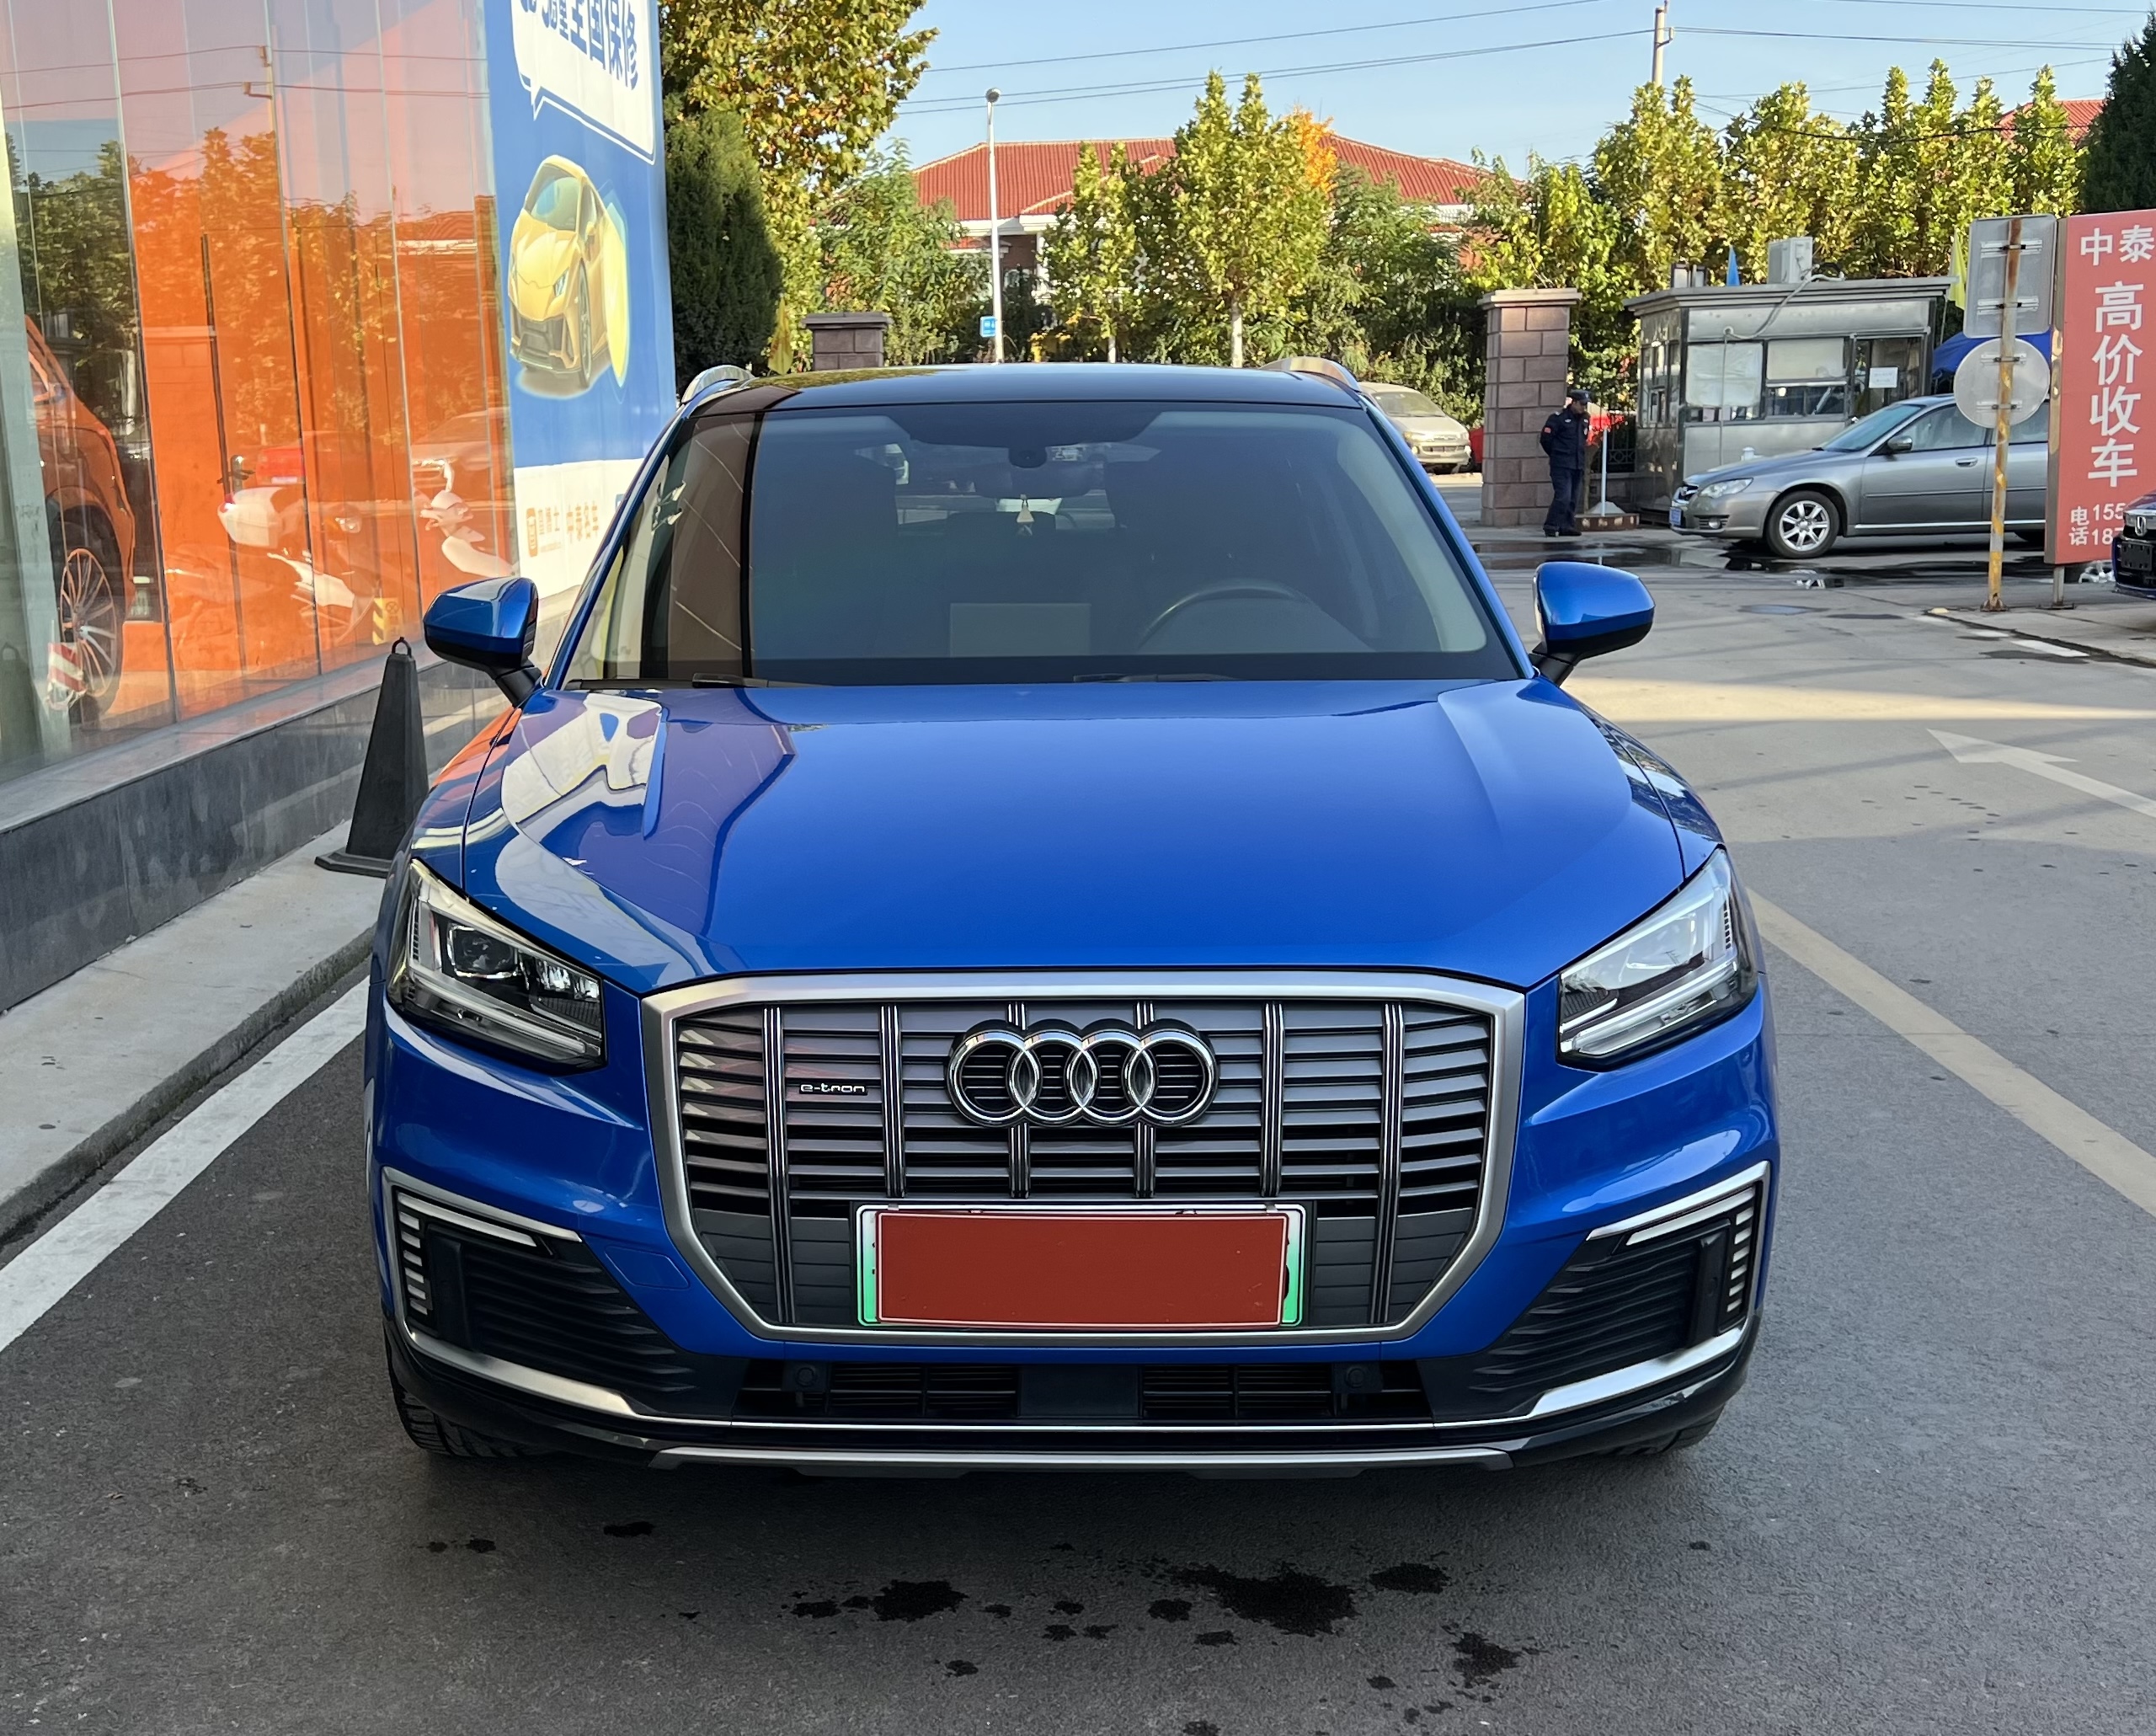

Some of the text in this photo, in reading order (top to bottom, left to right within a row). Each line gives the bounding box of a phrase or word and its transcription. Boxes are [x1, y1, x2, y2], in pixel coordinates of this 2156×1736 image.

[2080, 224, 2155, 266] 中泰
[2087, 280, 2144, 488] 高价收车
[2068, 506, 2089, 546] 电话
[800, 1082, 865, 1093] e-tron
